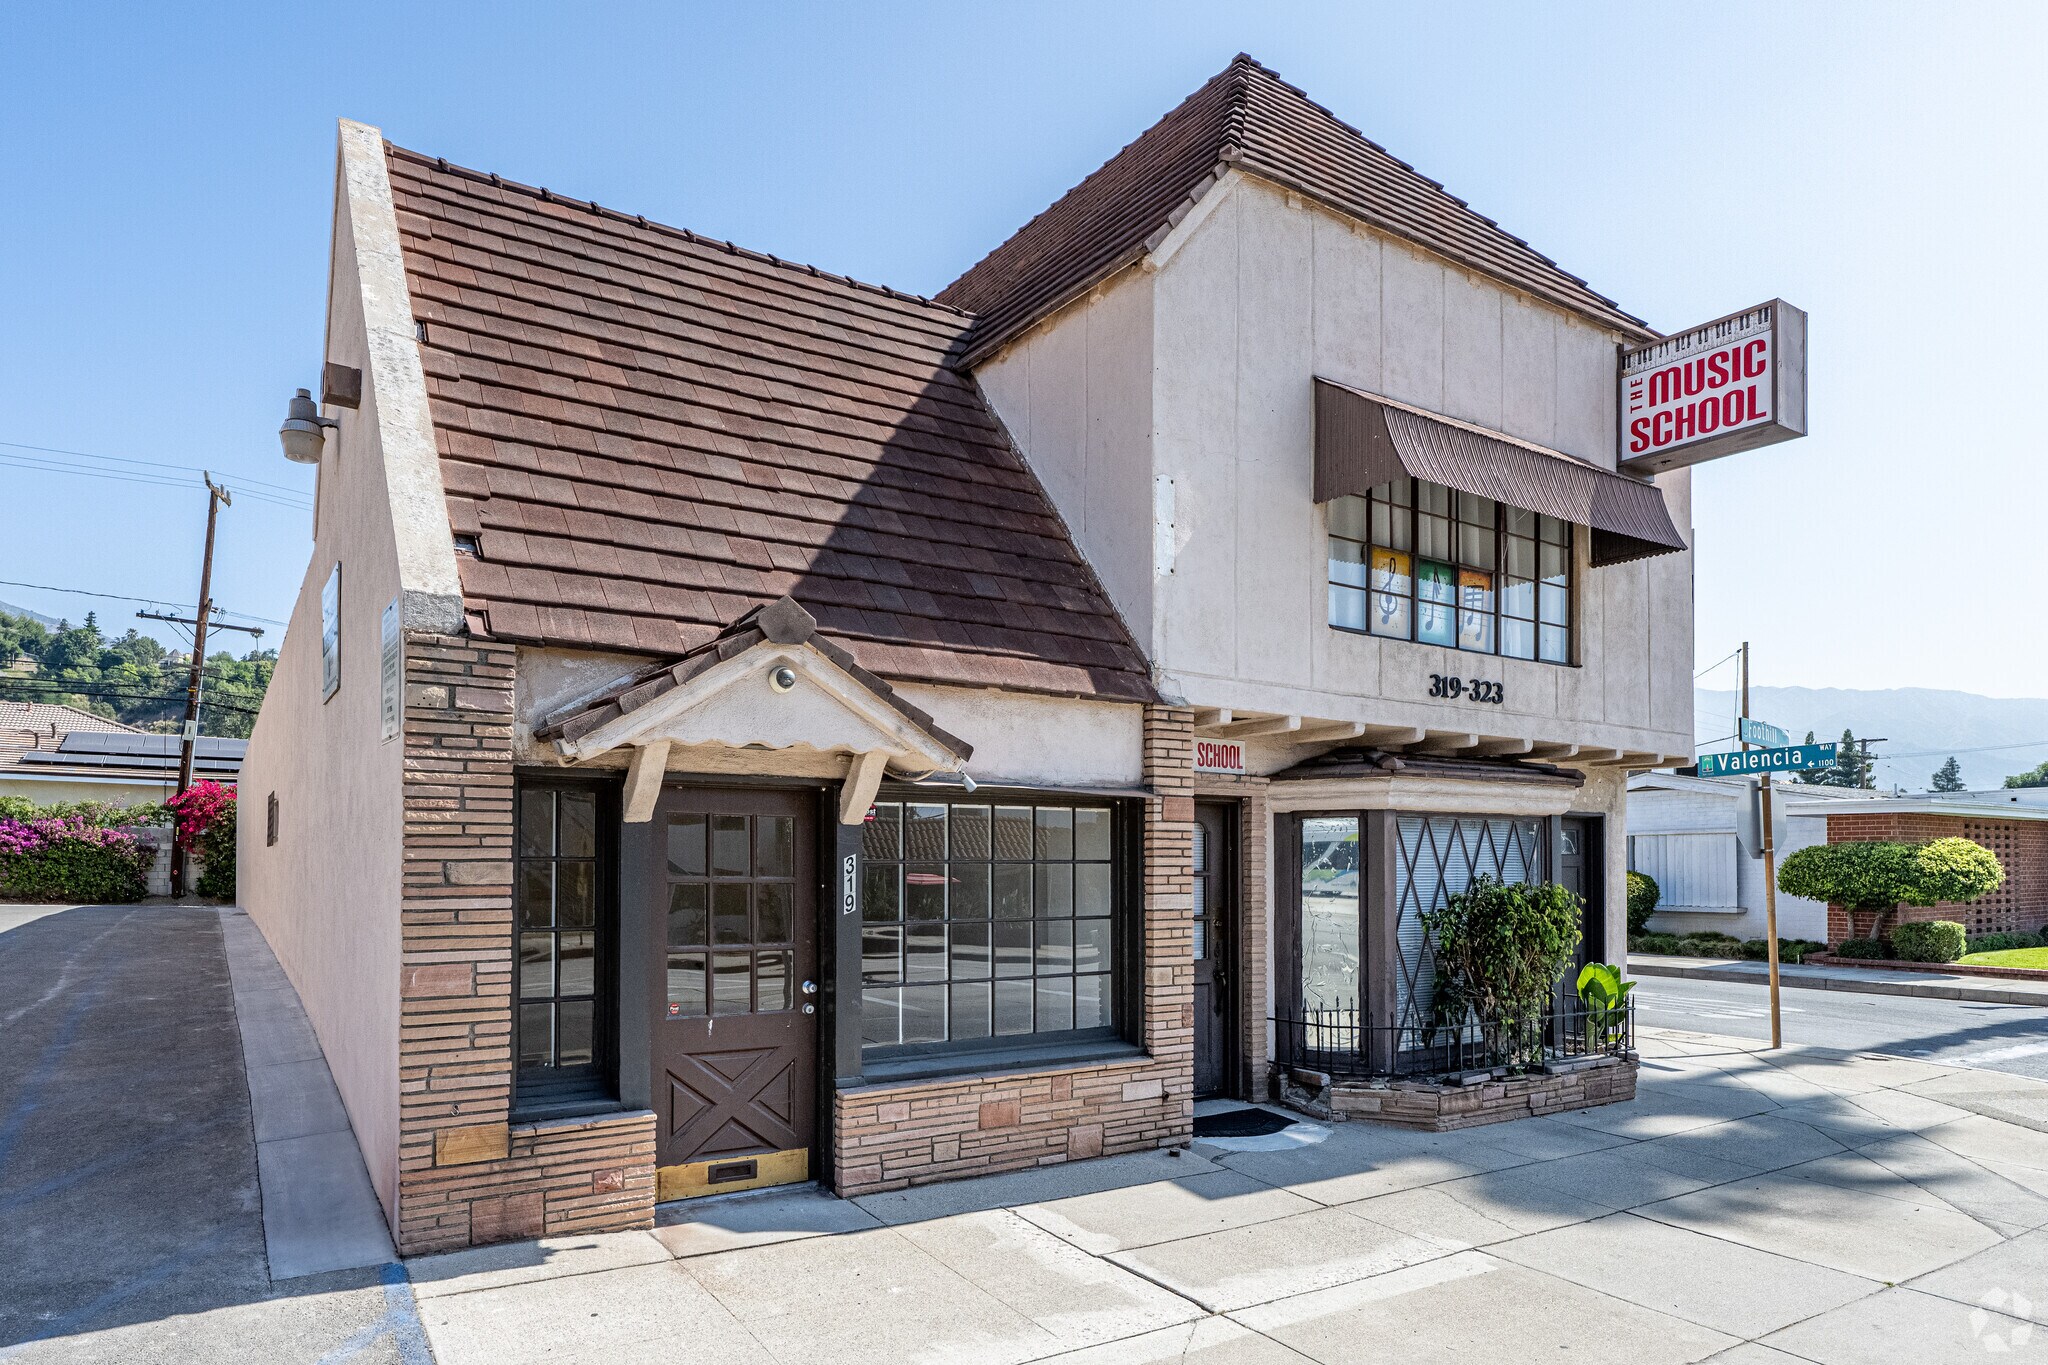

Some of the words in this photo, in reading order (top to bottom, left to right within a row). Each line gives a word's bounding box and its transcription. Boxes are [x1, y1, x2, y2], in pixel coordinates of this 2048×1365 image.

[1648, 339, 1767, 408] MUSIC
[1630, 377, 1643, 414] THE
[1630, 385, 1767, 453] SCHOOL
[1428, 674, 1504, 704] 319-323
[1749, 721, 1777, 744] Foothill
[1197, 742, 1243, 769] SCHOOL
[1717, 747, 1802, 771] Valencia
[1818, 743, 1833, 751] WAY
[1818, 758, 1834, 767] 1100
[845, 856, 855, 913] 319
